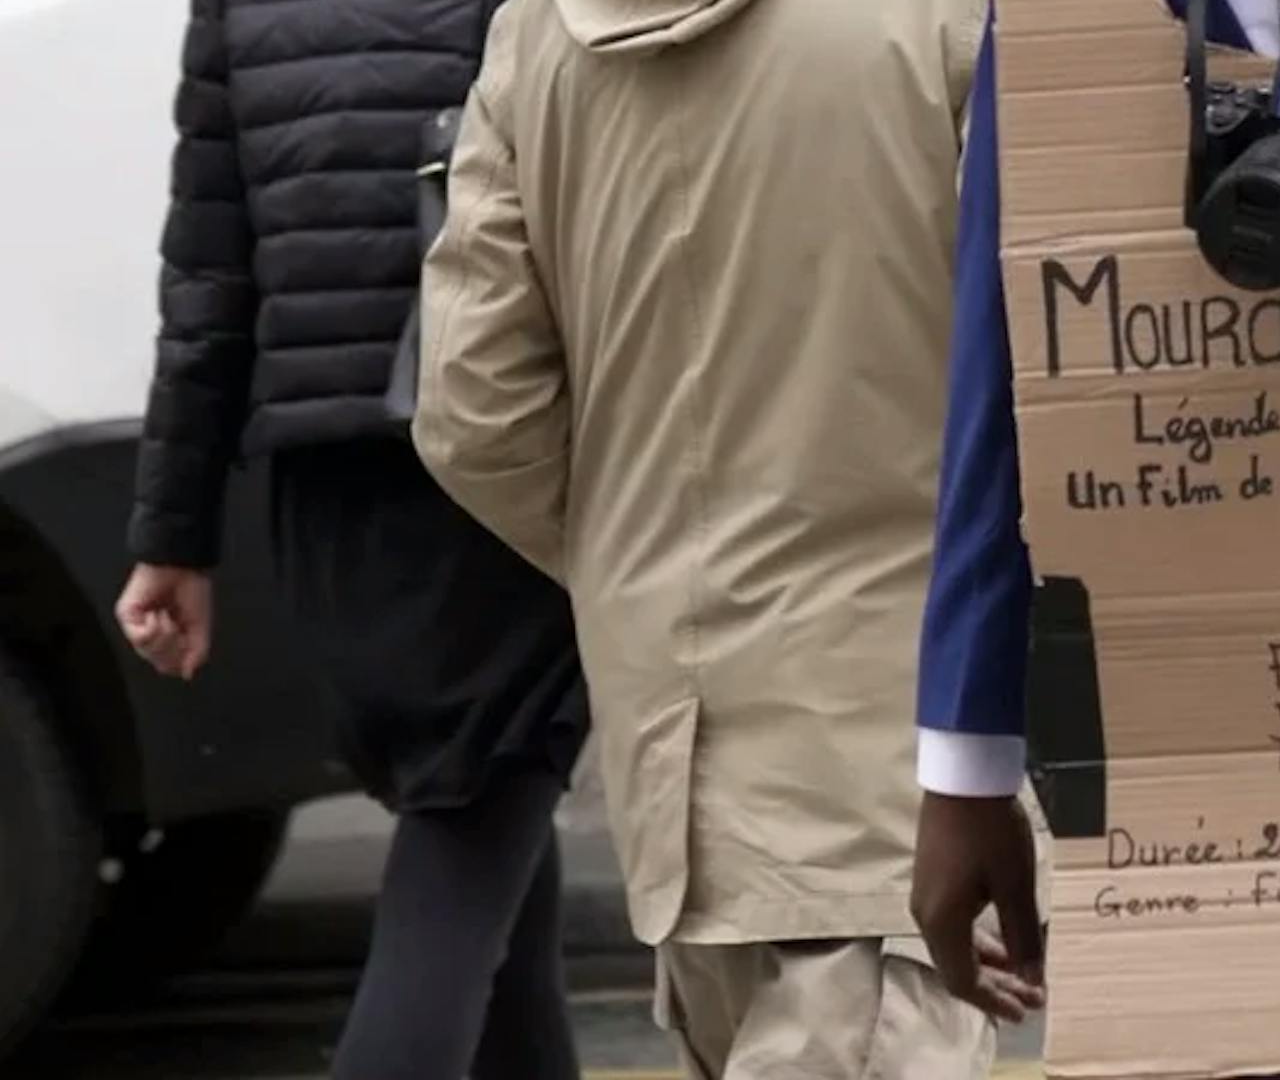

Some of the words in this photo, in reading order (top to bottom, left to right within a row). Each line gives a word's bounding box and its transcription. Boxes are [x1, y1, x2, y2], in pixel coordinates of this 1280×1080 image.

[1134, 392, 1280, 463] Légende
[1068, 471, 1124, 509] Un
[1240, 455, 1273, 499] de
[1094, 886, 1199, 918] Genre
